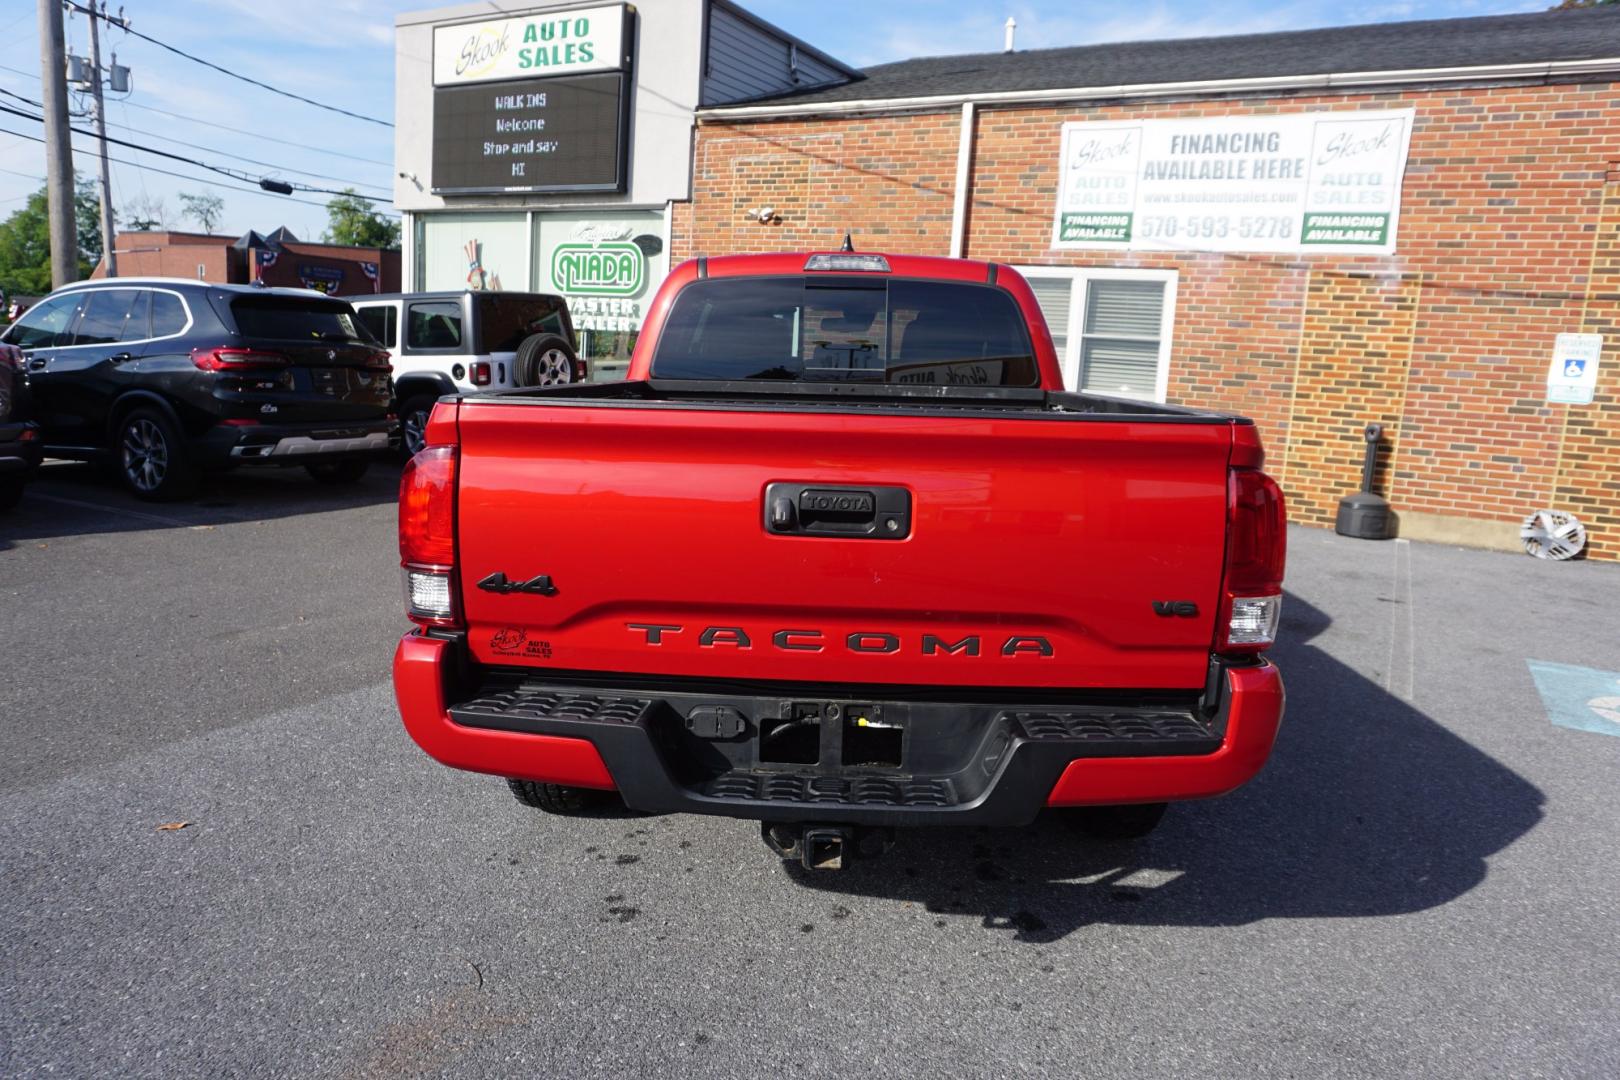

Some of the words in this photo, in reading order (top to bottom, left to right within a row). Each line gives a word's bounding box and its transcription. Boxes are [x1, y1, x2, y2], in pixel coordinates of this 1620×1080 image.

[523, 17, 589, 43] AUTO
[455, 22, 510, 76] Skook
[518, 41, 594, 69] SALES
[495, 94, 525, 111] WALK
[483, 141, 510, 156] Stop
[511, 139, 534, 154] and
[1170, 132, 1281, 155] FINANCING
[1316, 123, 1392, 166] Skook
[511, 162, 526, 177] HI
[1143, 159, 1248, 181] AVAILABLE
[1252, 157, 1305, 180] HERE
[1075, 176, 1127, 189] AUTO
[1320, 172, 1384, 187] AUTO
[1069, 191, 1129, 205] SALES
[1313, 190, 1387, 205] SALES
[1066, 215, 1129, 226] FINANCING
[1141, 214, 1294, 239] 570-593-5278
[1307, 215, 1386, 228] FINANCING
[1063, 227, 1128, 239] AVAILABLE
[1305, 229, 1383, 241] AVAILABLE
[558, 251, 634, 284] NIADA
[572, 315, 632, 331] EALER
[808, 496, 871, 511] TOYOTA
[1151, 600, 1198, 617] V6
[625, 622, 1056, 659] TACOMA
